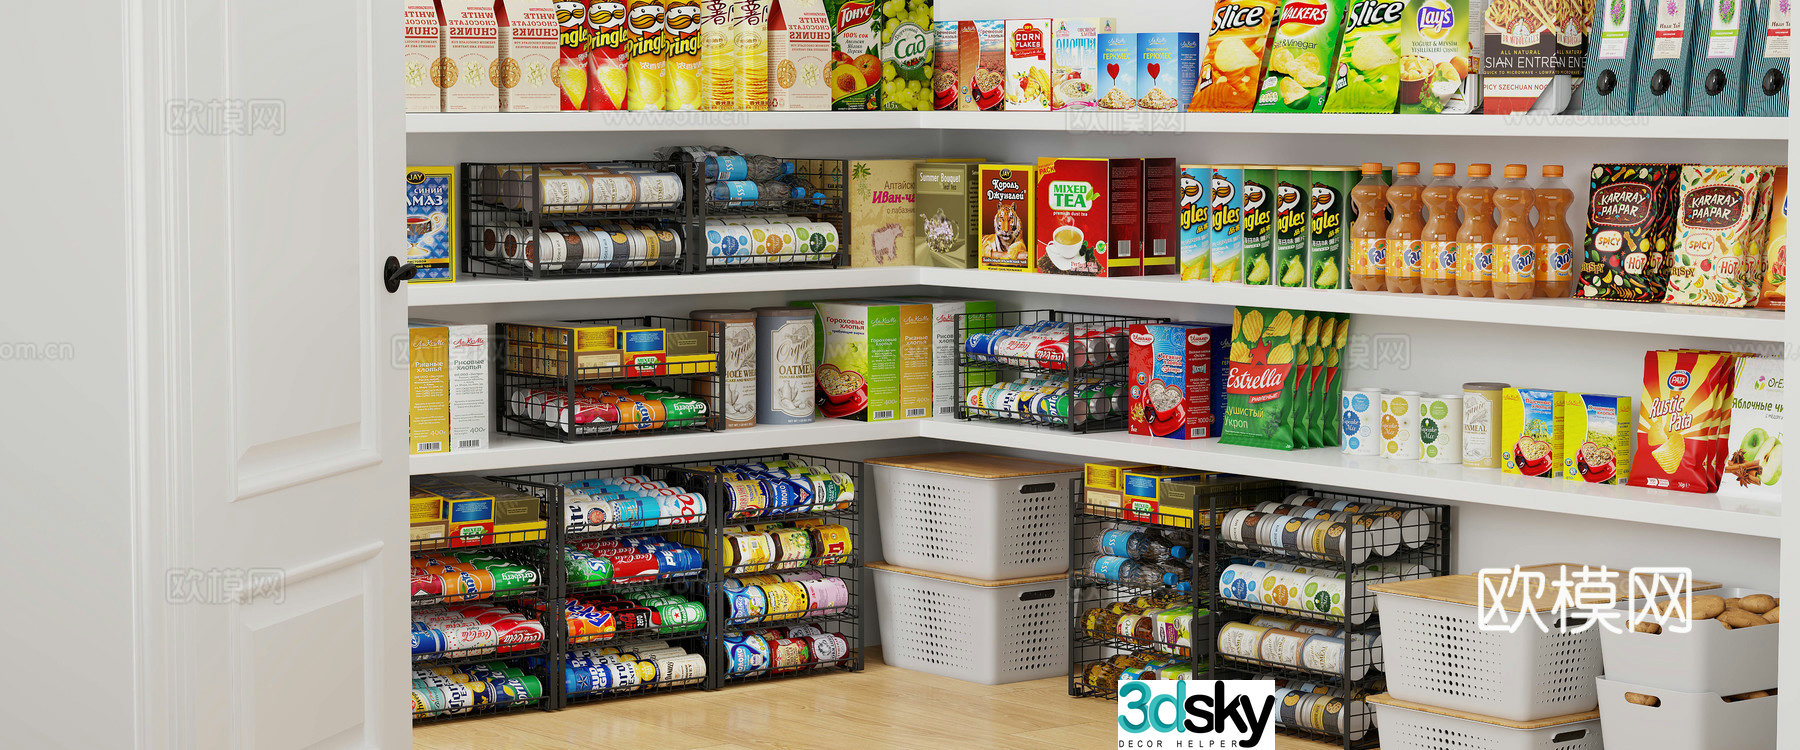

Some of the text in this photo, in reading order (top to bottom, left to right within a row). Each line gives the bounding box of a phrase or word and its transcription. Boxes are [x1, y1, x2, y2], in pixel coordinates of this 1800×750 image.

[840, 4, 874, 28] Тонус
[1209, 4, 1265, 36] Slice
[1282, 7, 1327, 21] WALKERS
[1345, 1, 1404, 34] Slice
[1420, 7, 1452, 33] Lay's
[560, 26, 587, 48] ngle
[587, 26, 628, 53] Pringle
[1015, 33, 1041, 41] CORN
[628, 31, 665, 60] Pringl
[894, 34, 926, 60] Сад
[1143, 52, 1171, 60] ГЕРКУЛЕС
[1484, 53, 1556, 69] SIAN ENTRÉ
[884, 180, 915, 190] Алтайск
[940, 172, 961, 184] Bouquet
[992, 179, 1020, 191] Король
[1053, 184, 1087, 193] MIXED
[407, 195, 443, 206] МАЗ
[872, 191, 915, 204] Иван-ча
[1053, 193, 1086, 208] TEA
[1601, 191, 1647, 205] KARARAY
[1691, 194, 1739, 208] KARARAY
[1181, 204, 1208, 230] ngles
[1601, 203, 1639, 217] PAAPAR
[1691, 206, 1731, 220] PAAPAR
[1212, 205, 1240, 231] ngles
[1244, 209, 1271, 232] ngles
[1278, 210, 1305, 233] ngles
[1312, 212, 1340, 235] ngles
[1597, 236, 1621, 246] SPICY
[1688, 240, 1713, 250] SPICY
[1582, 261, 1605, 273] RISPY
[1628, 257, 1646, 269] HOT
[1720, 261, 1738, 275] HOT
[1670, 266, 1695, 278] RISPY
[826, 316, 865, 326] Гороховые
[840, 323, 865, 331] хлопья
[1227, 367, 1283, 389] Estrella
[1649, 395, 1685, 419] Rustic
[1669, 411, 1693, 432] Pata
